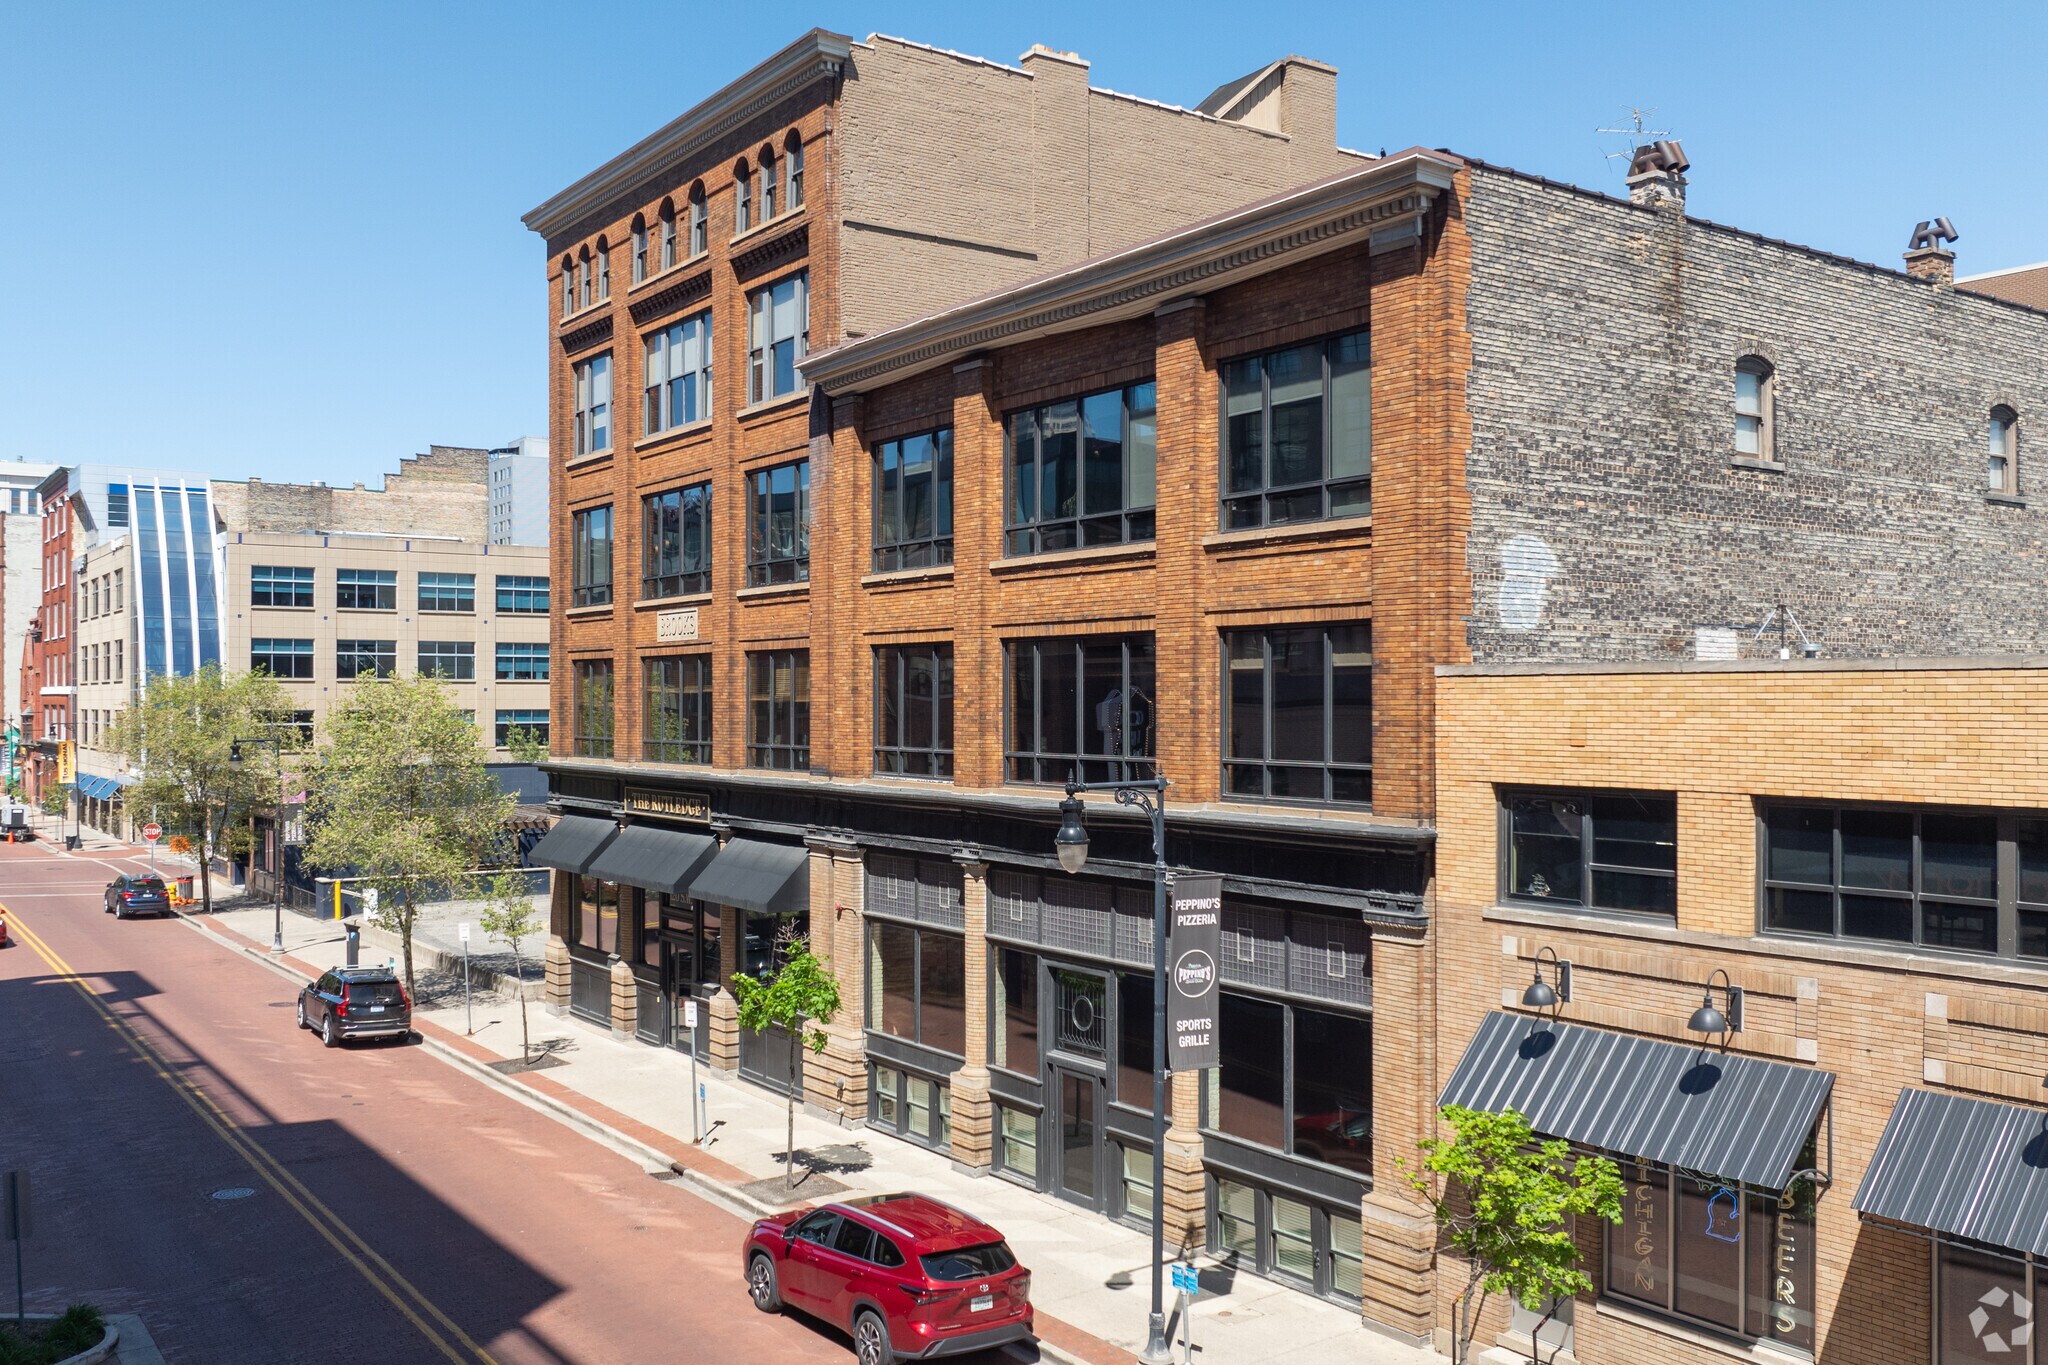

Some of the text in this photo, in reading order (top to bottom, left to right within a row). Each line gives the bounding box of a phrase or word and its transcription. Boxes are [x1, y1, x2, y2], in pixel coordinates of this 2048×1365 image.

[660, 615, 695, 637] BROOKS
[632, 792, 702, 816] THE RUTLEDGE
[145, 828, 161, 836] STOP
[1175, 897, 1221, 911] PEPPINO'S
[1177, 913, 1217, 926] PIZZERIA
[1176, 1018, 1212, 1032] SPORTS
[1178, 1034, 1210, 1048] GRILLE
[1776, 1187, 1796, 1333] BEERS
